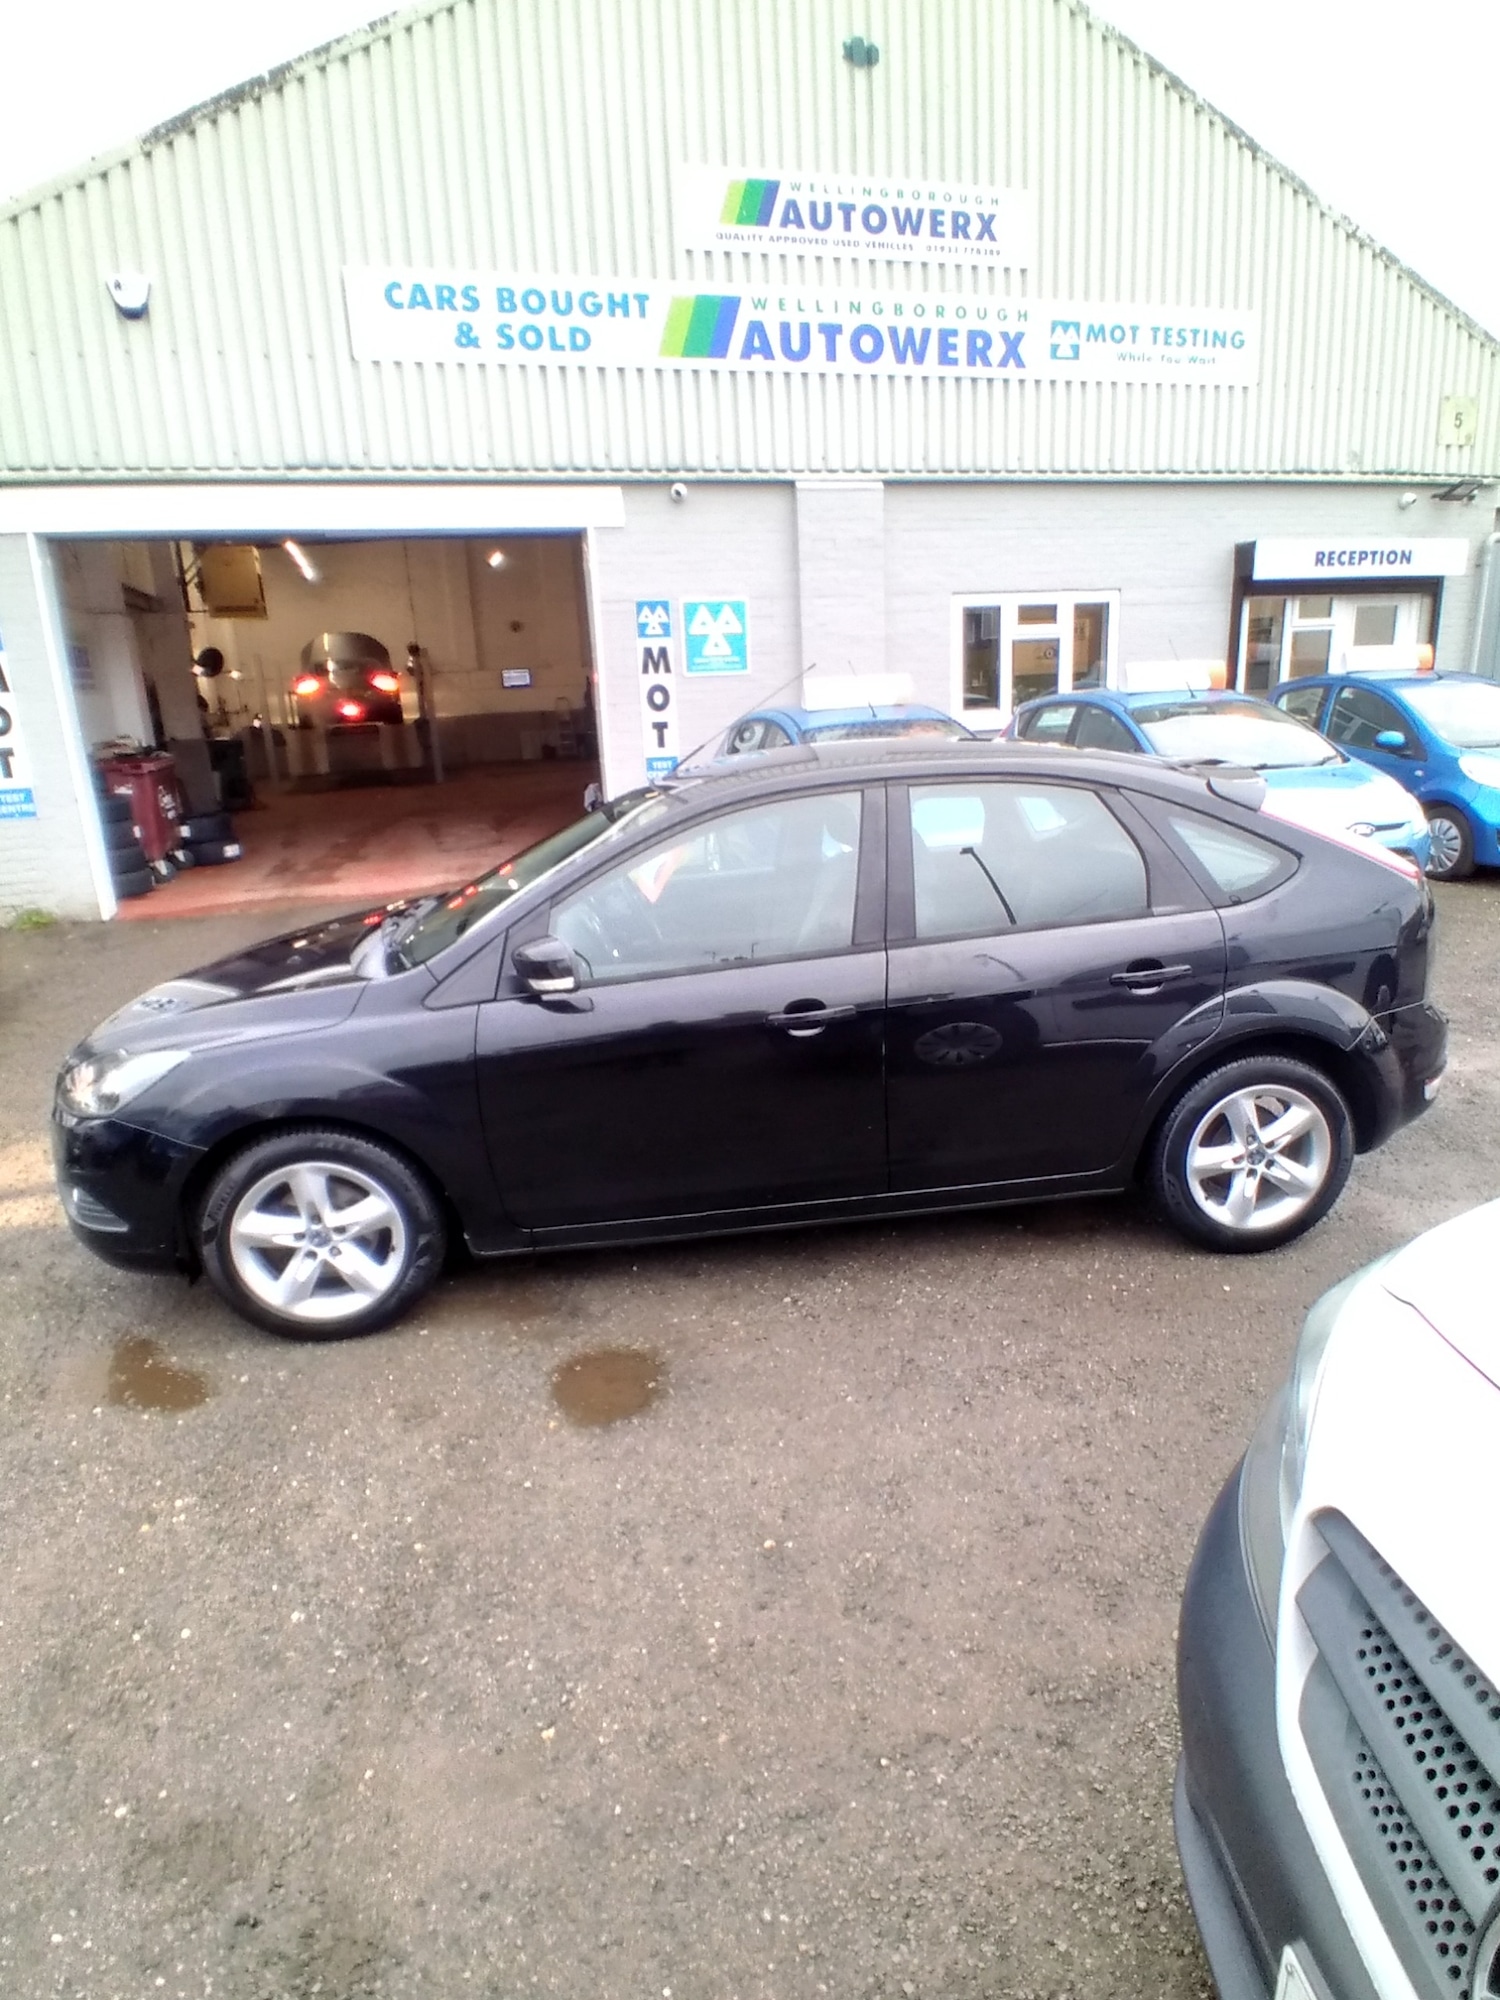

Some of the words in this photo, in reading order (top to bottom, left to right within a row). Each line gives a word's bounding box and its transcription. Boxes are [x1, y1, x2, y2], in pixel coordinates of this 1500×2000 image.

[789, 181, 1000, 207] WELLINGBOROUGH
[779, 198, 999, 243] AUTOWERX
[716, 232, 763, 242] QUALITY
[768, 235, 828, 246] APPROVED
[865, 241, 913, 252] VEHICLES
[384, 281, 481, 313] CARS
[495, 286, 651, 319] BOUGHT
[751, 296, 1028, 323] WELLINGBOROUGH
[454, 321, 482, 350] &
[496, 322, 592, 352] SOLD
[739, 320, 1026, 369] AUTOWERX
[1086, 323, 1140, 345] MOT
[1150, 326, 1246, 350] TESTING
[1117, 351, 1153, 362] While
[1454, 411, 1463, 429] 5
[1314, 549, 1413, 568] RECEPTION
[642, 646, 672, 748] MOT
